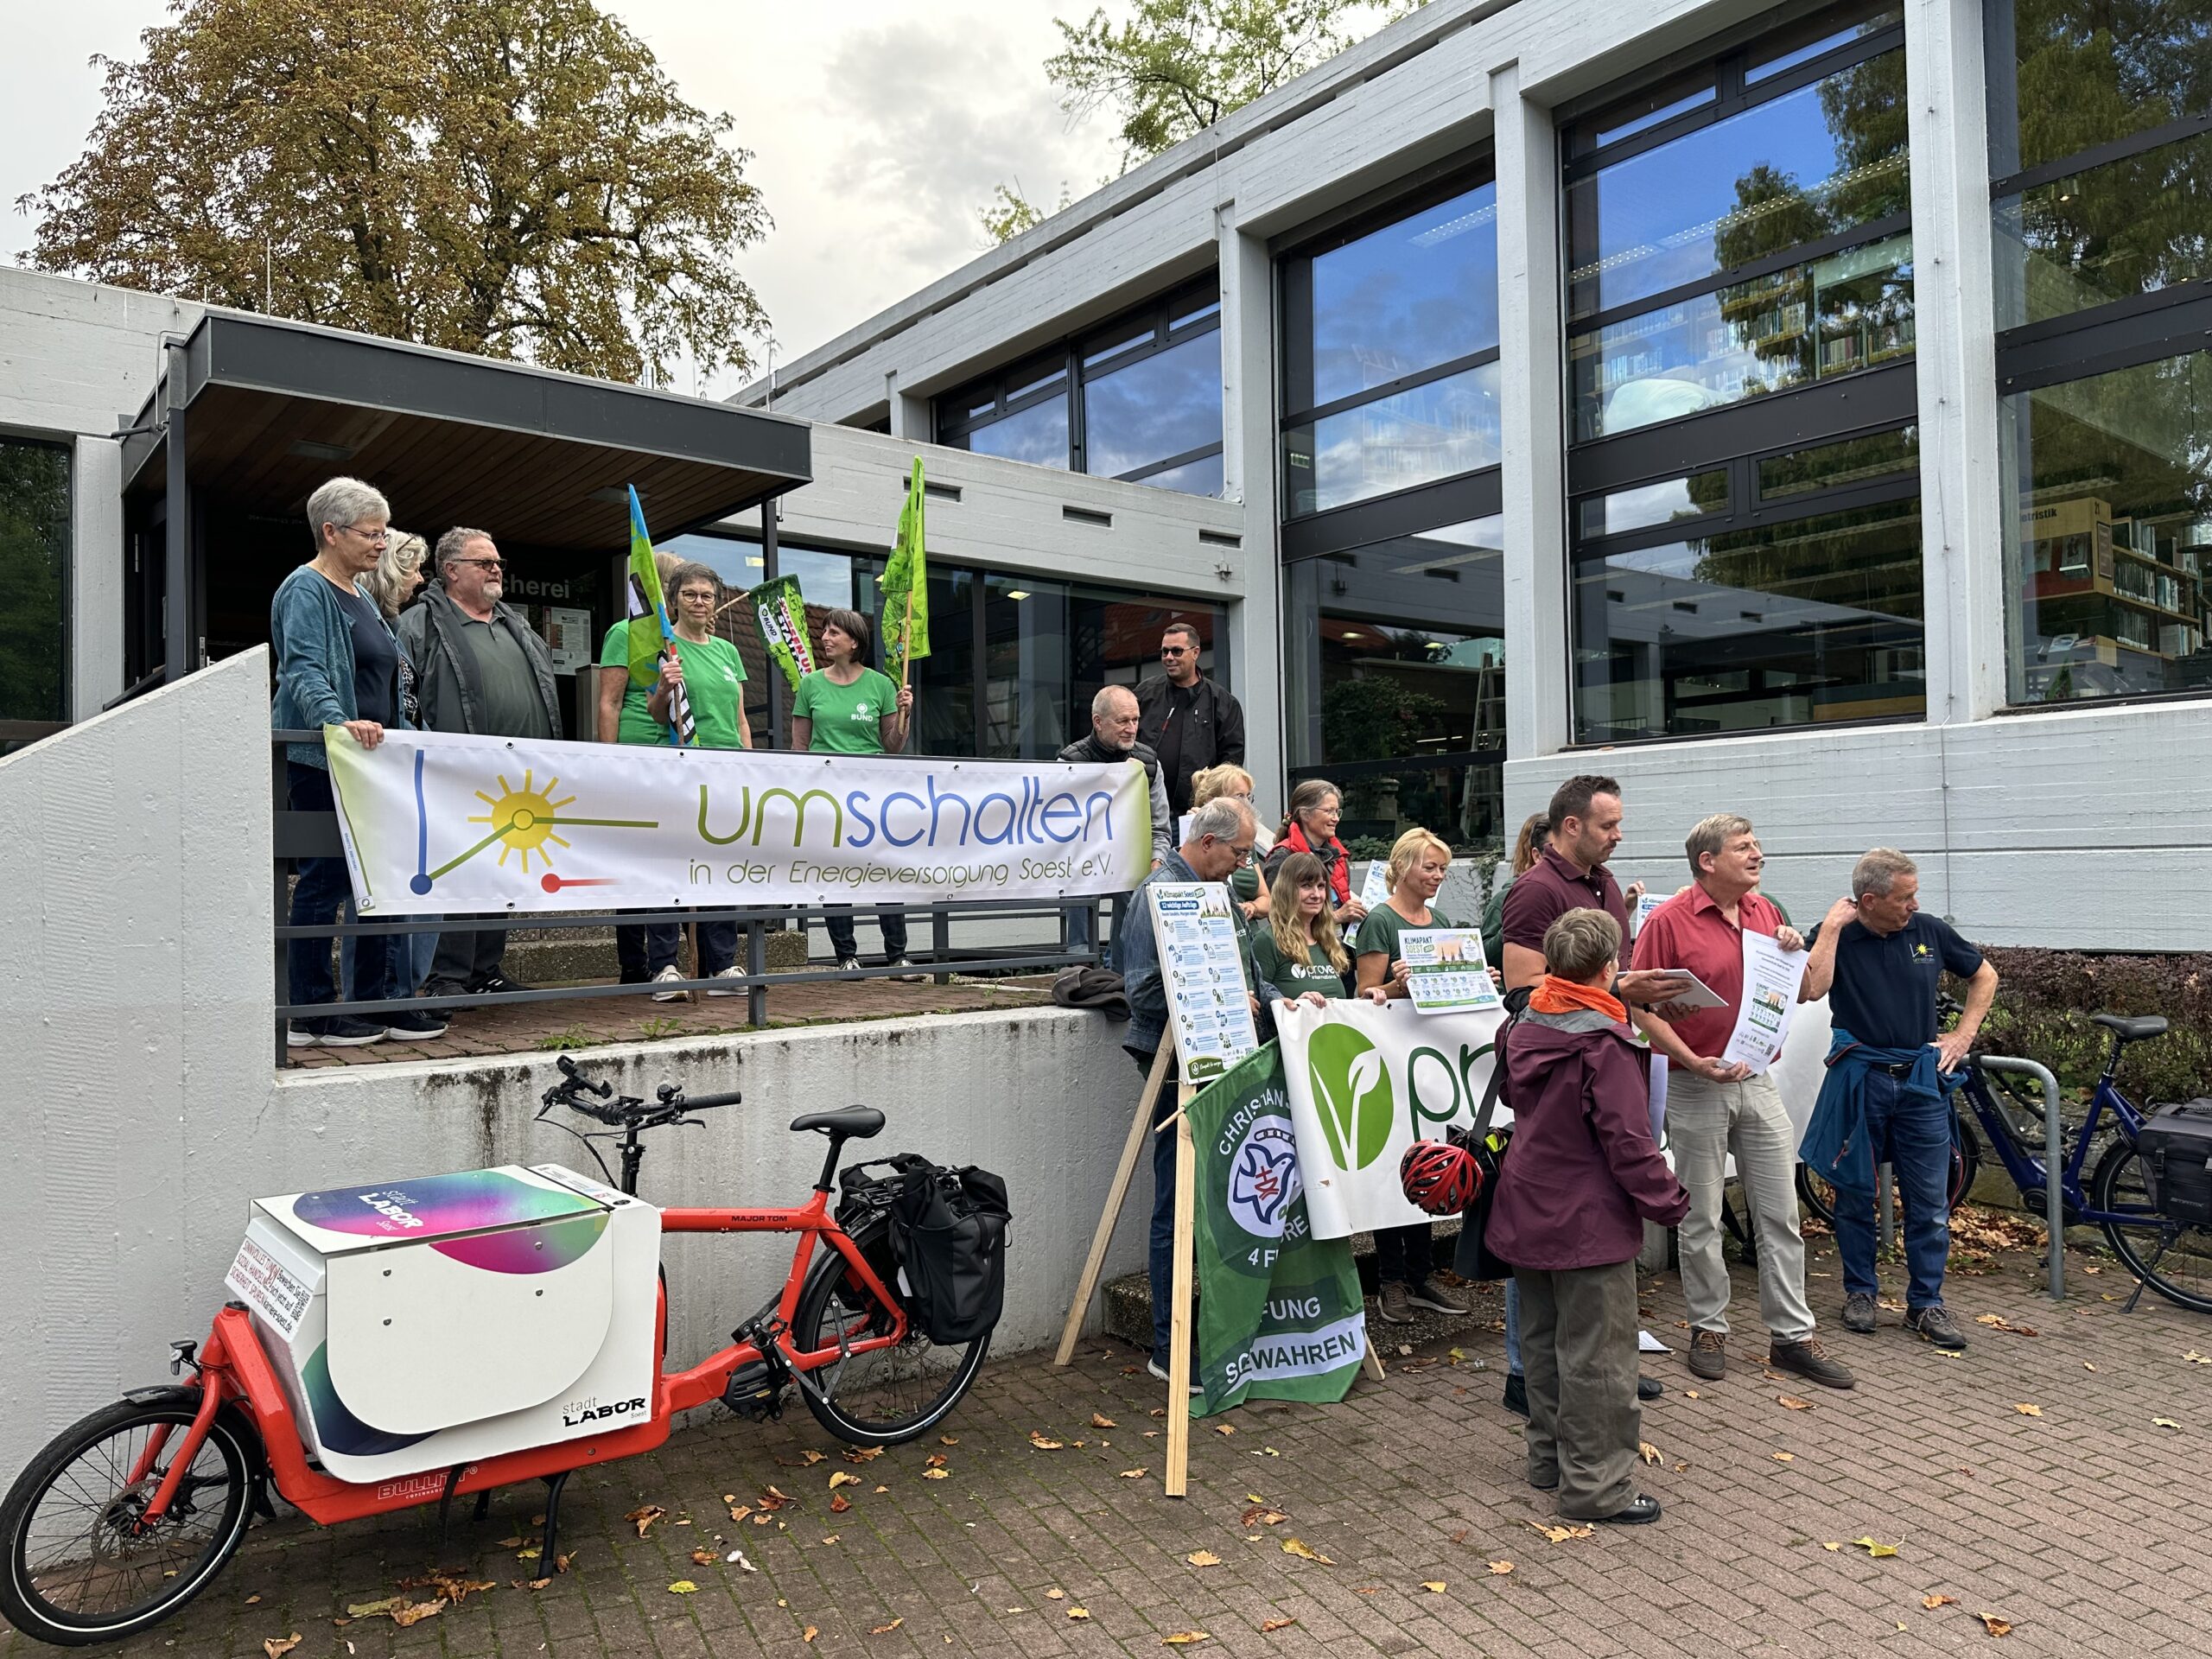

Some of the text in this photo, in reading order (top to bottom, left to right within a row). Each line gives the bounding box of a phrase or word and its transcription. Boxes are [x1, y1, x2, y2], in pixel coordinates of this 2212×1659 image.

[763, 617, 778, 637] BUND
[850, 713, 874, 722] BUND
[696, 774, 1115, 849] umschalten
[689, 853, 1116, 888] in der Energieversorgung Soest e.V.
[1404, 936, 1433, 944] KLIMAPAKT
[1405, 944, 1424, 954] SOEST
[382, 1190, 419, 1205] stadt
[358, 1192, 424, 1229] LABOR
[1247, 1248, 1259, 1265] 4
[563, 1395, 597, 1414] stadt
[563, 1397, 646, 1427] LABOR
